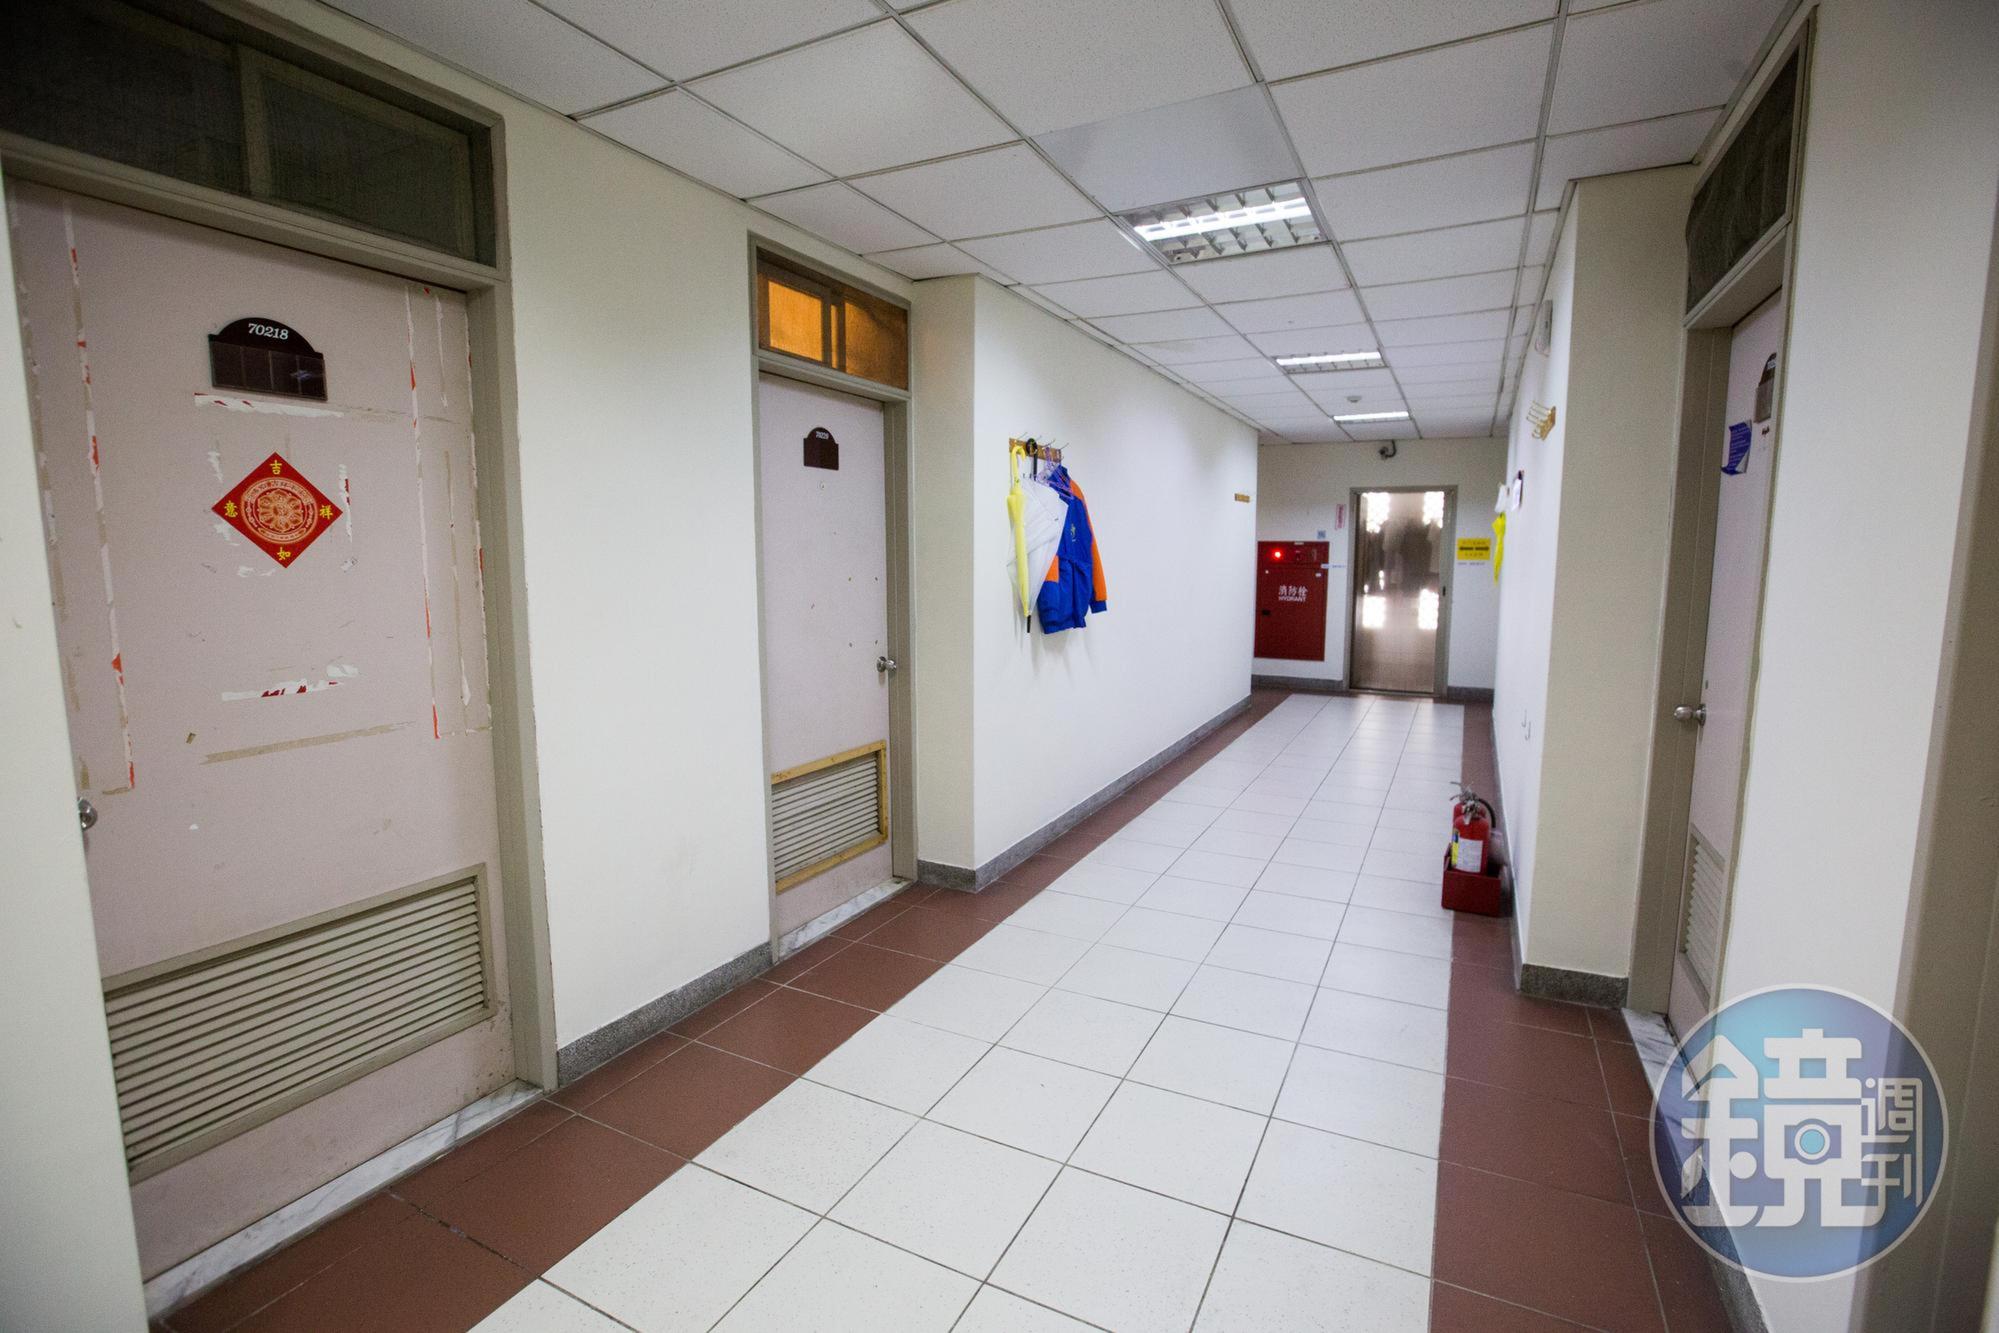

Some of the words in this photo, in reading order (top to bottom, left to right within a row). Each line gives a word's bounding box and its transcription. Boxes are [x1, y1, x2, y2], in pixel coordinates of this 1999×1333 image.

[248, 323, 289, 340] 70218
[270, 459, 282, 475] 吉
[224, 500, 238, 517] 意
[319, 504, 333, 519] 祥
[277, 546, 291, 560] 如
[1278, 584, 1308, 596] 消防栓
